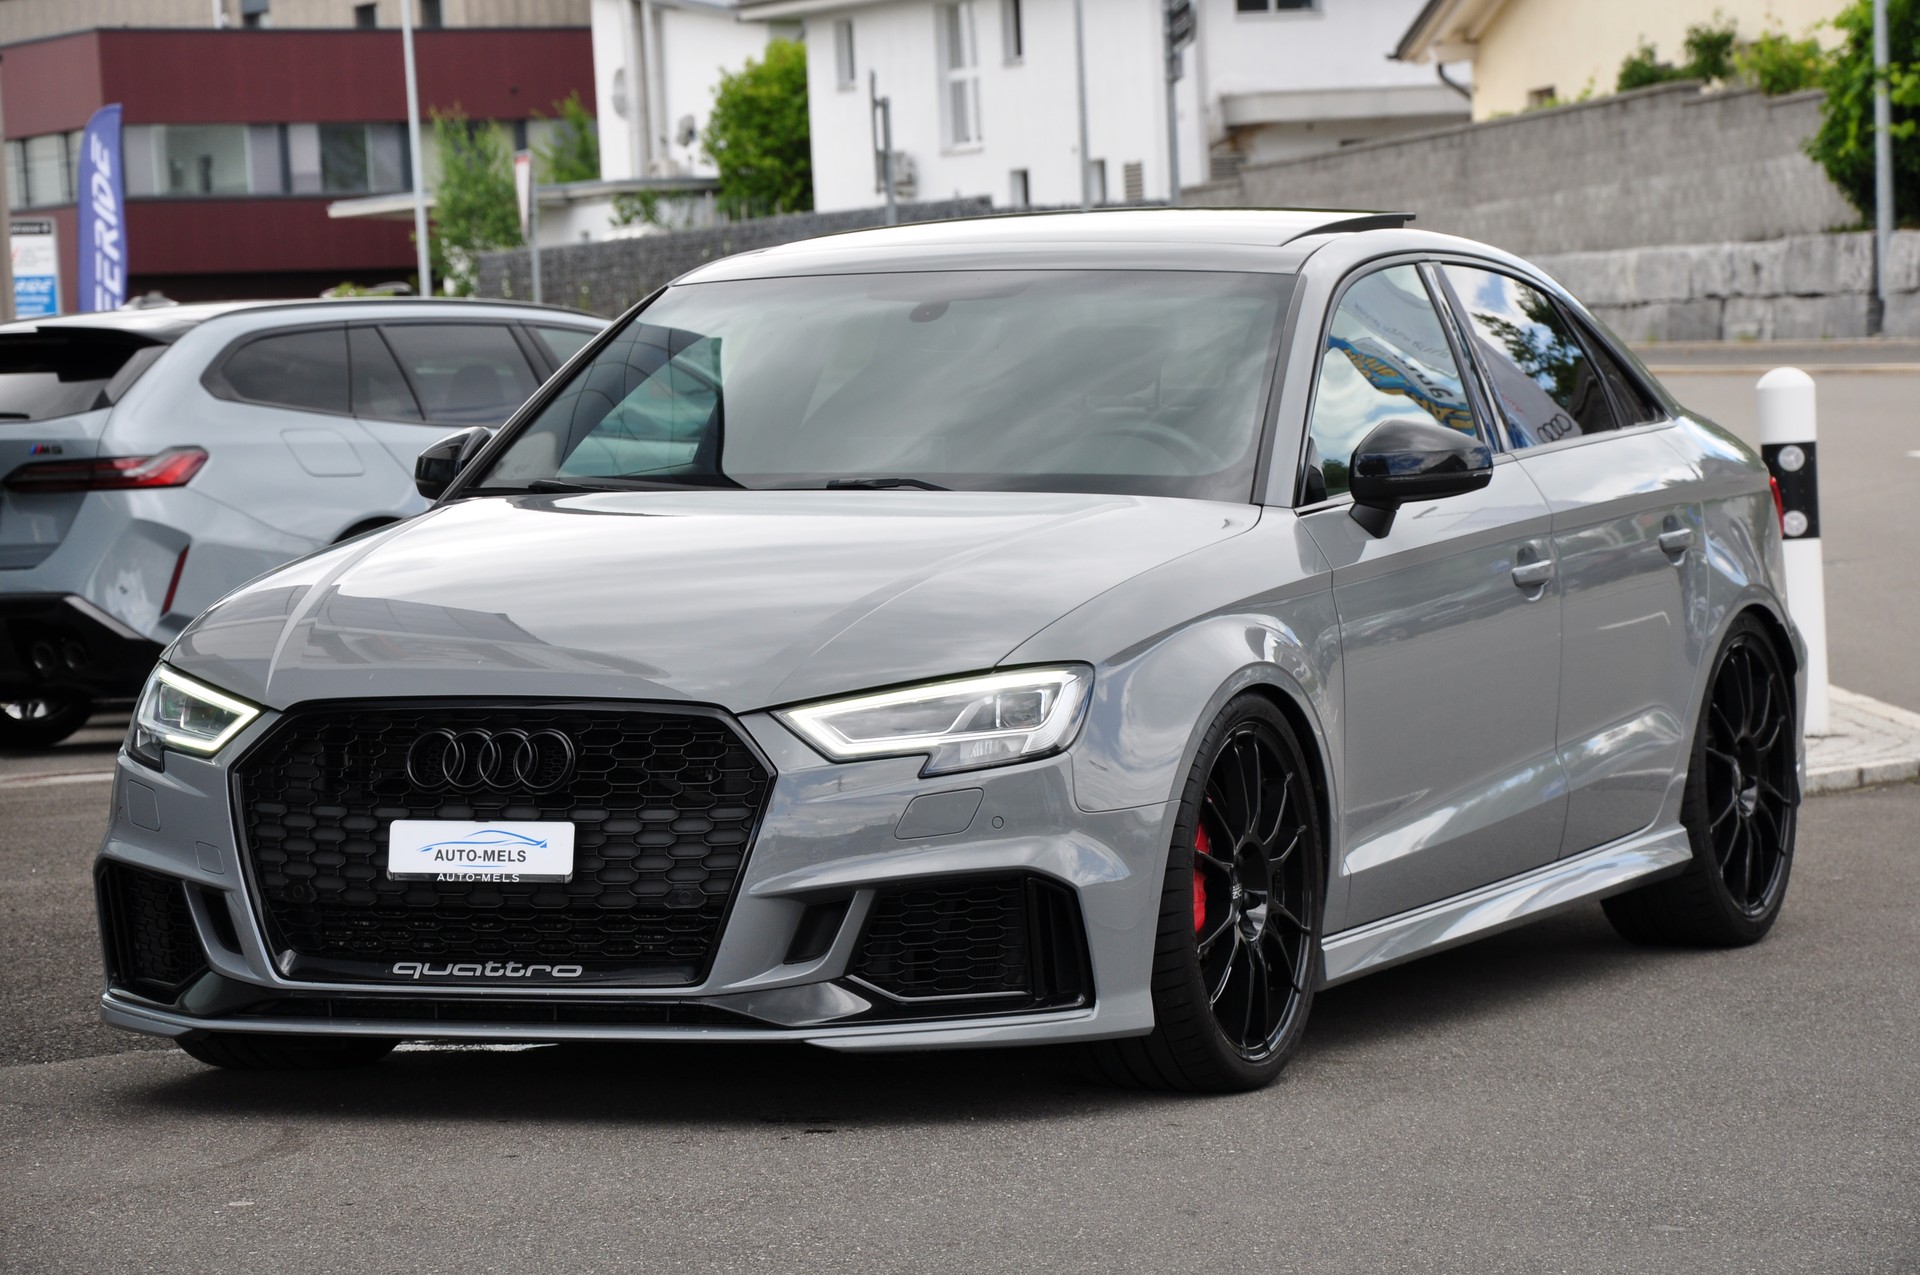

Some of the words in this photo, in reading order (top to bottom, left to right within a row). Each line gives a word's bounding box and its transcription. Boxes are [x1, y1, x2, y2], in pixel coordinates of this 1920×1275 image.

[434, 849, 527, 863] AUTO-MELS
[436, 873, 521, 882] AUTO-MELS
[392, 960, 583, 979] quattro
